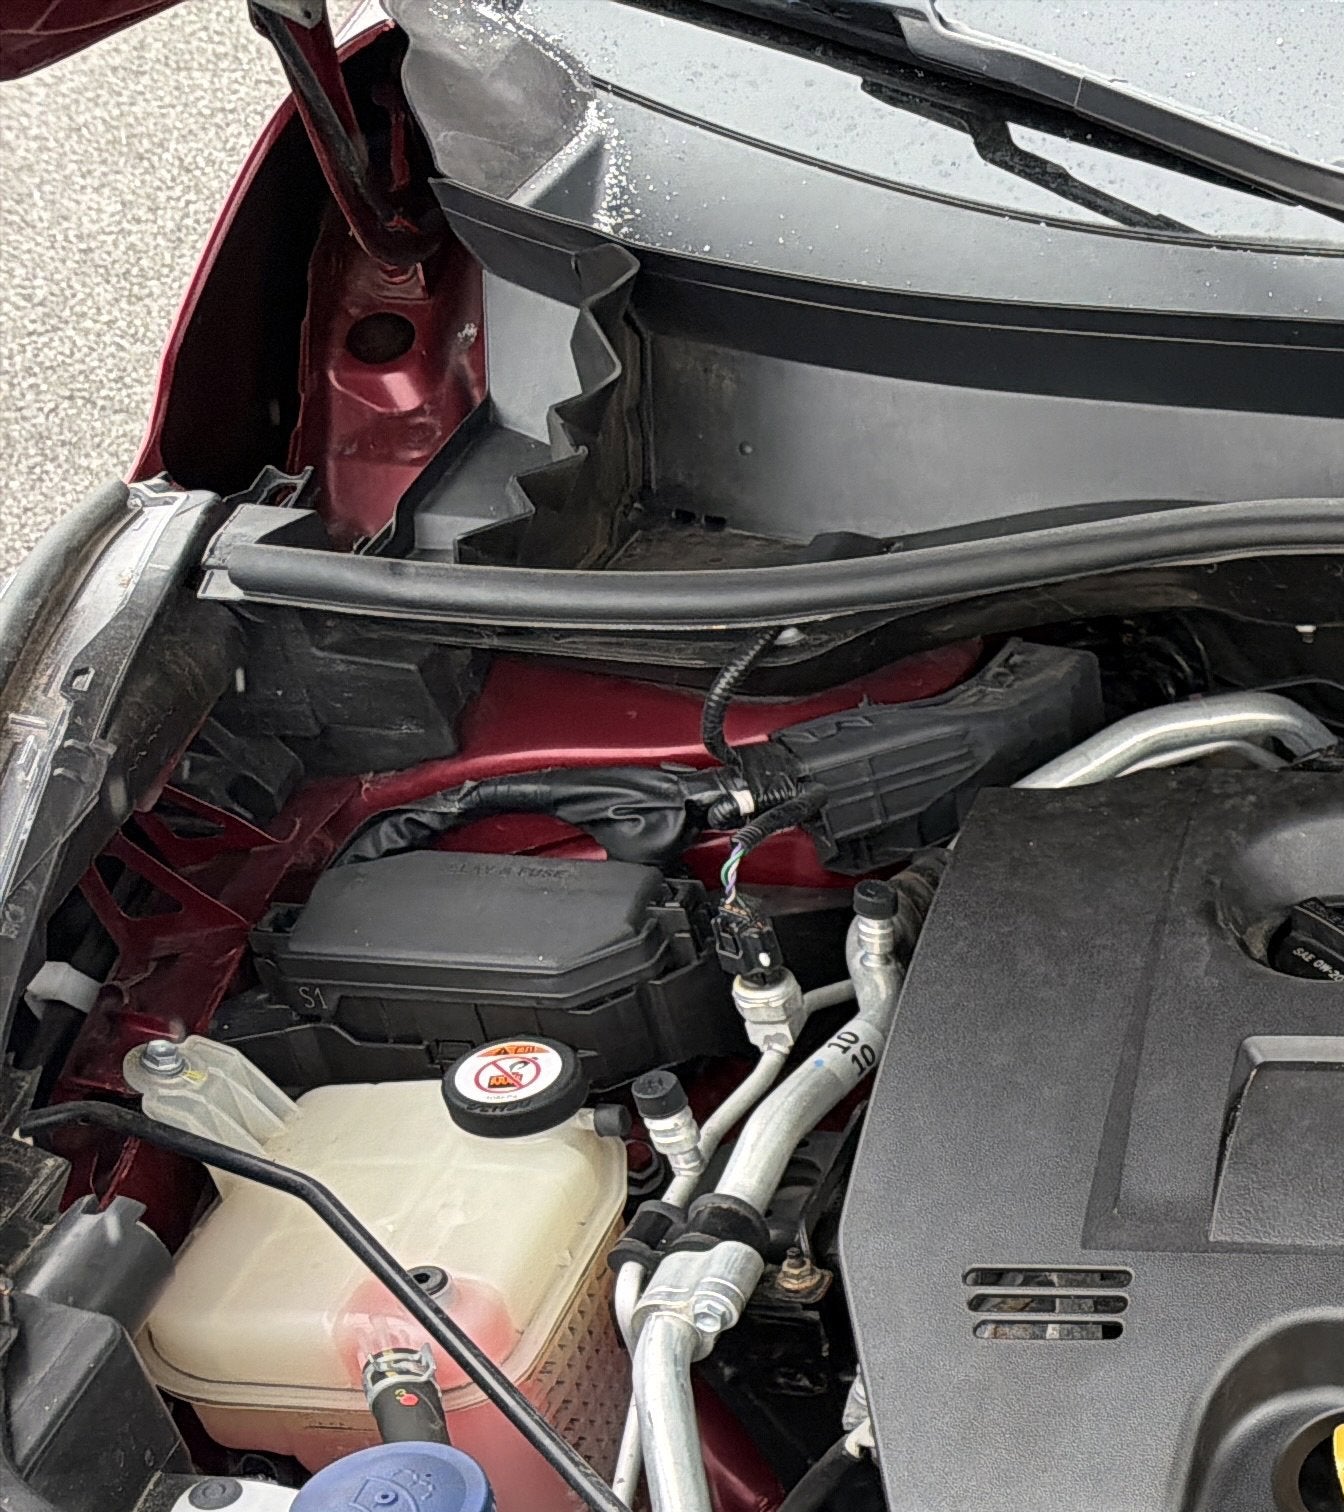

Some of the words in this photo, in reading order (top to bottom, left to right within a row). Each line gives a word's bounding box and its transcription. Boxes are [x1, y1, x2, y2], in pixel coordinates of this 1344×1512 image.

[1292, 947, 1316, 963] SAE
[299, 986, 328, 1009] S1
[828, 1031, 859, 1054] 10
[851, 1044, 876, 1077] 10
